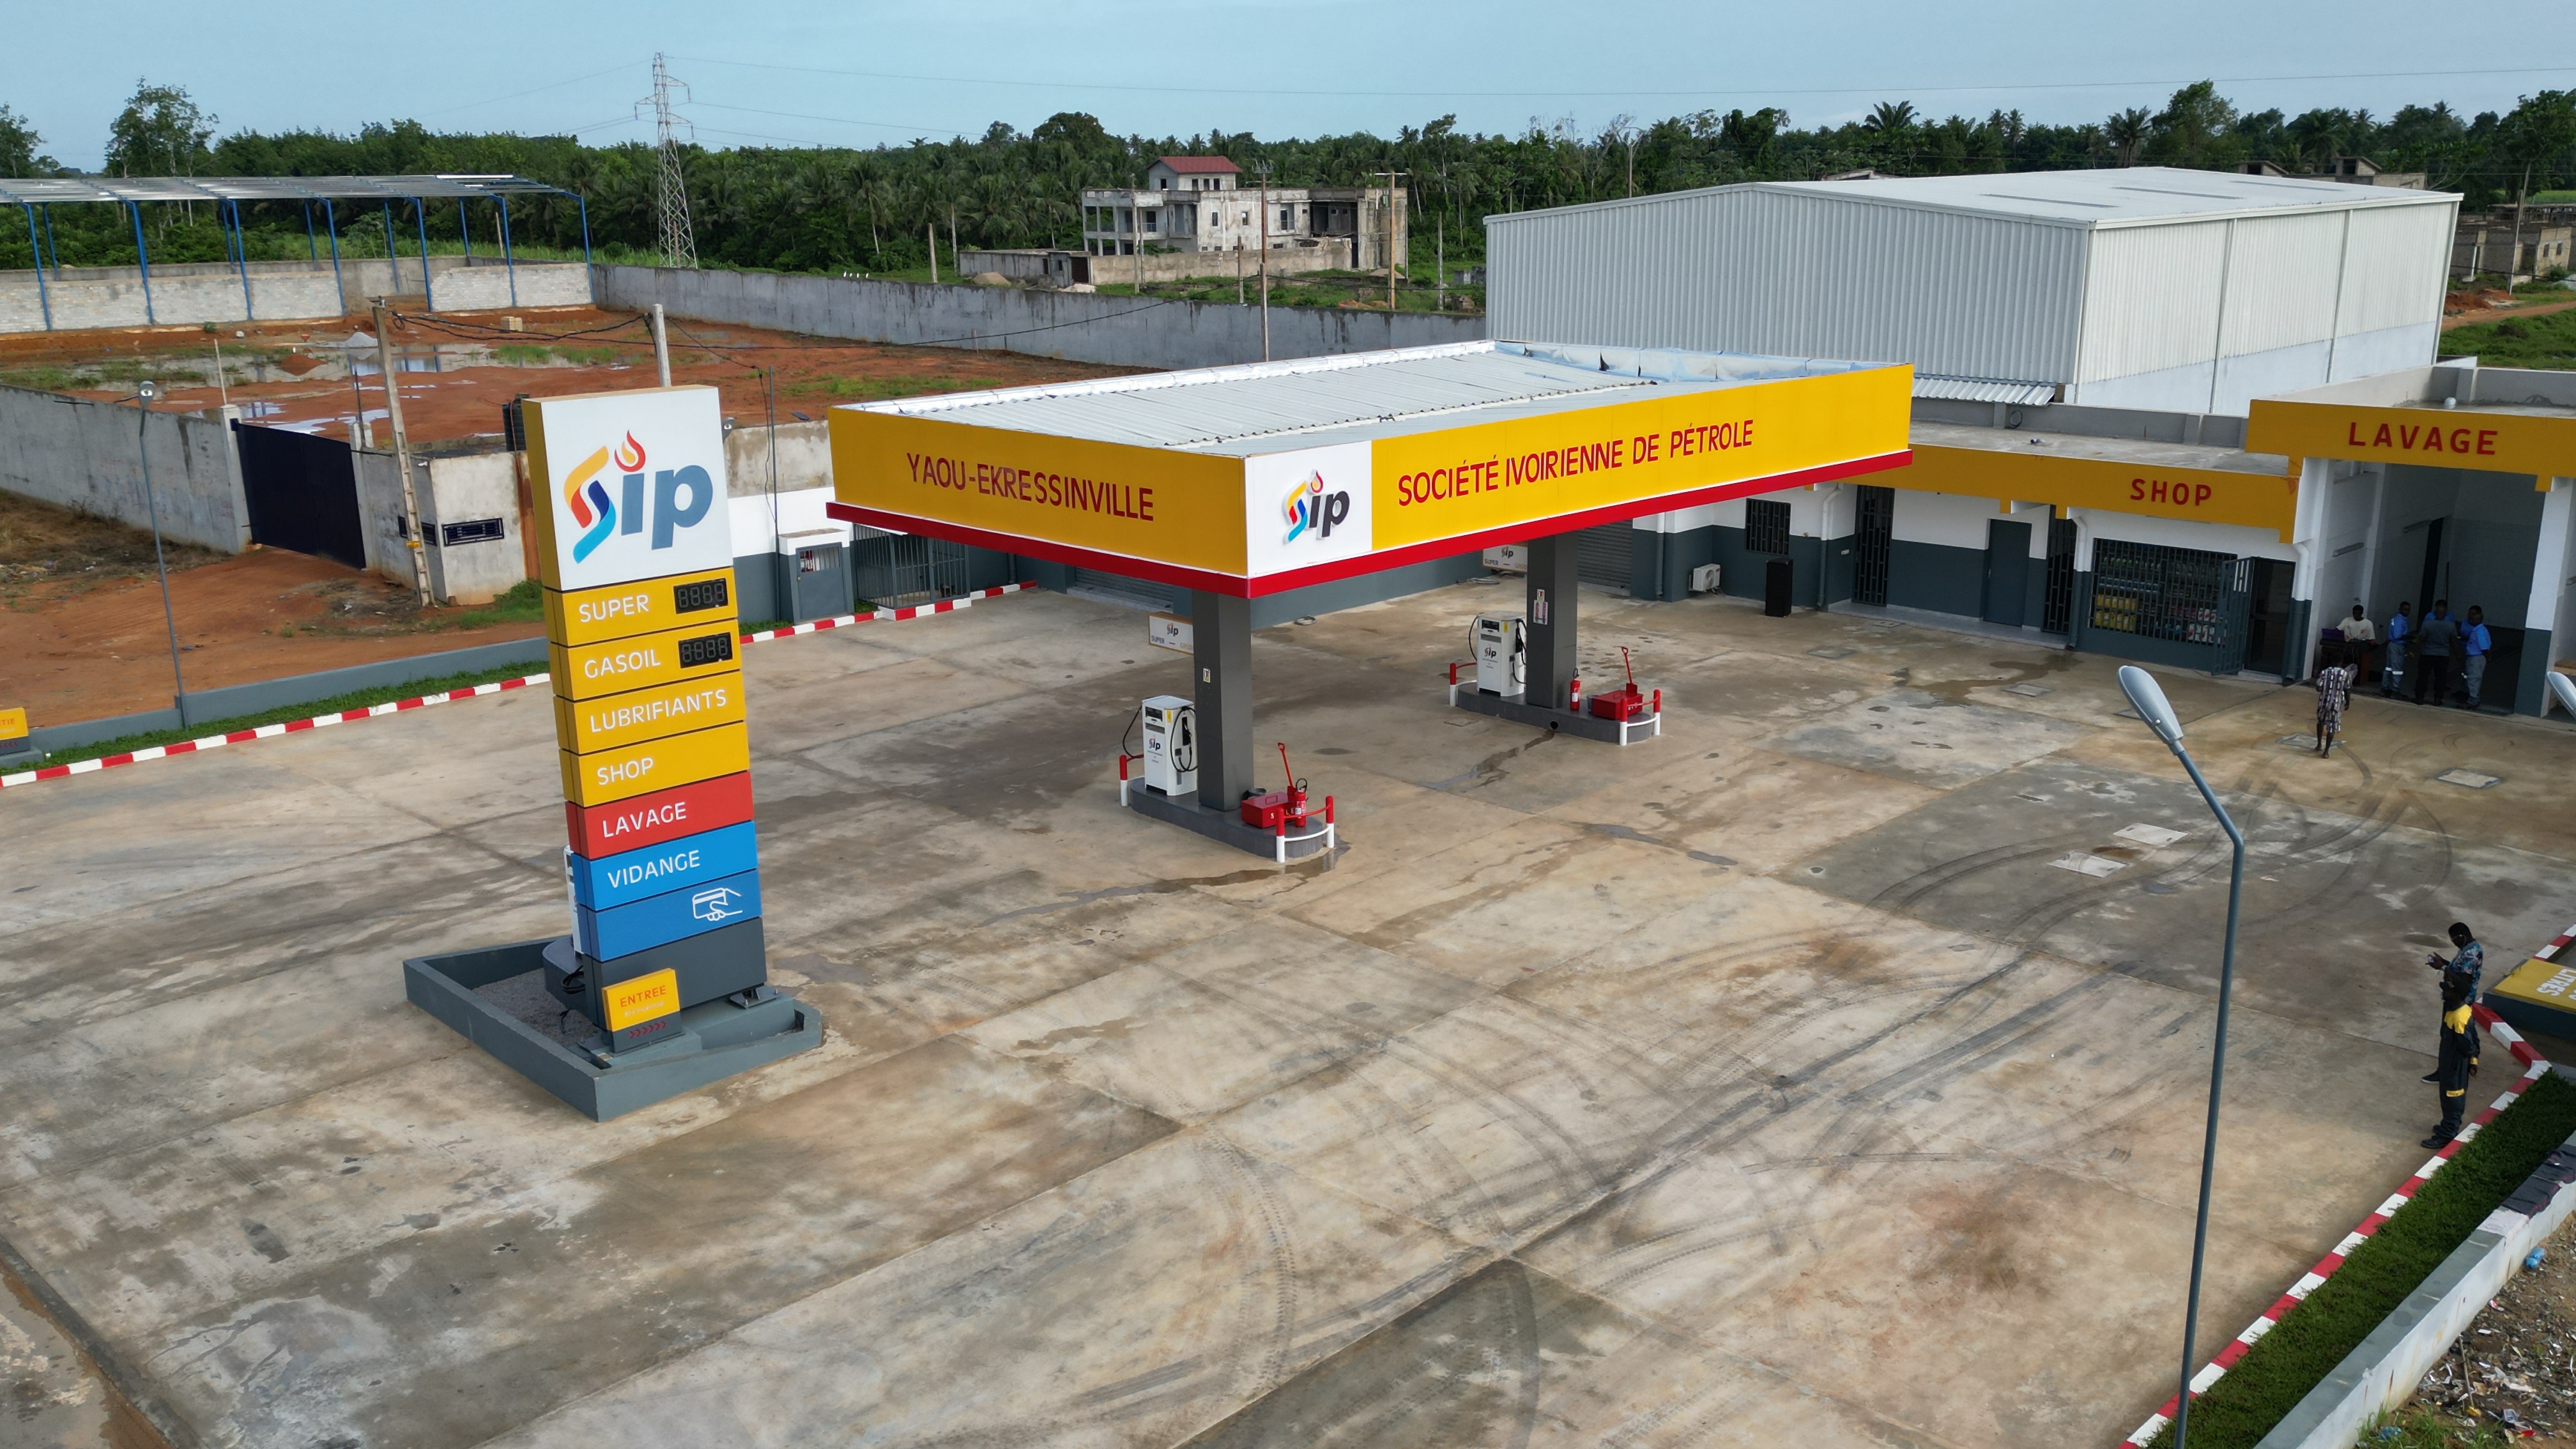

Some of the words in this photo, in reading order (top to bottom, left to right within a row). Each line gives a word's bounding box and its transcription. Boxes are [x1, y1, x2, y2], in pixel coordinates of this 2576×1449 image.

[2348, 421, 2499, 456] LAVAGE
[1397, 454, 1499, 507] SOCIÉTÉ
[1505, 440, 1623, 487] IVOIRIENNE
[1632, 434, 1660, 464] DE
[1670, 420, 1754, 458] PÉTROLE
[906, 452, 1154, 522] YAOU-EKRESSINVILLE
[2129, 478, 2212, 507] SHOP
[578, 594, 649, 624] SUPER
[584, 648, 661, 679] GASOIL
[590, 688, 727, 733] LUBRIFIANTS
[596, 757, 654, 786] SHOP
[602, 801, 687, 838] LAVAGE
[607, 849, 700, 888] VIDANGE
[619, 985, 667, 1008] ENTREE
